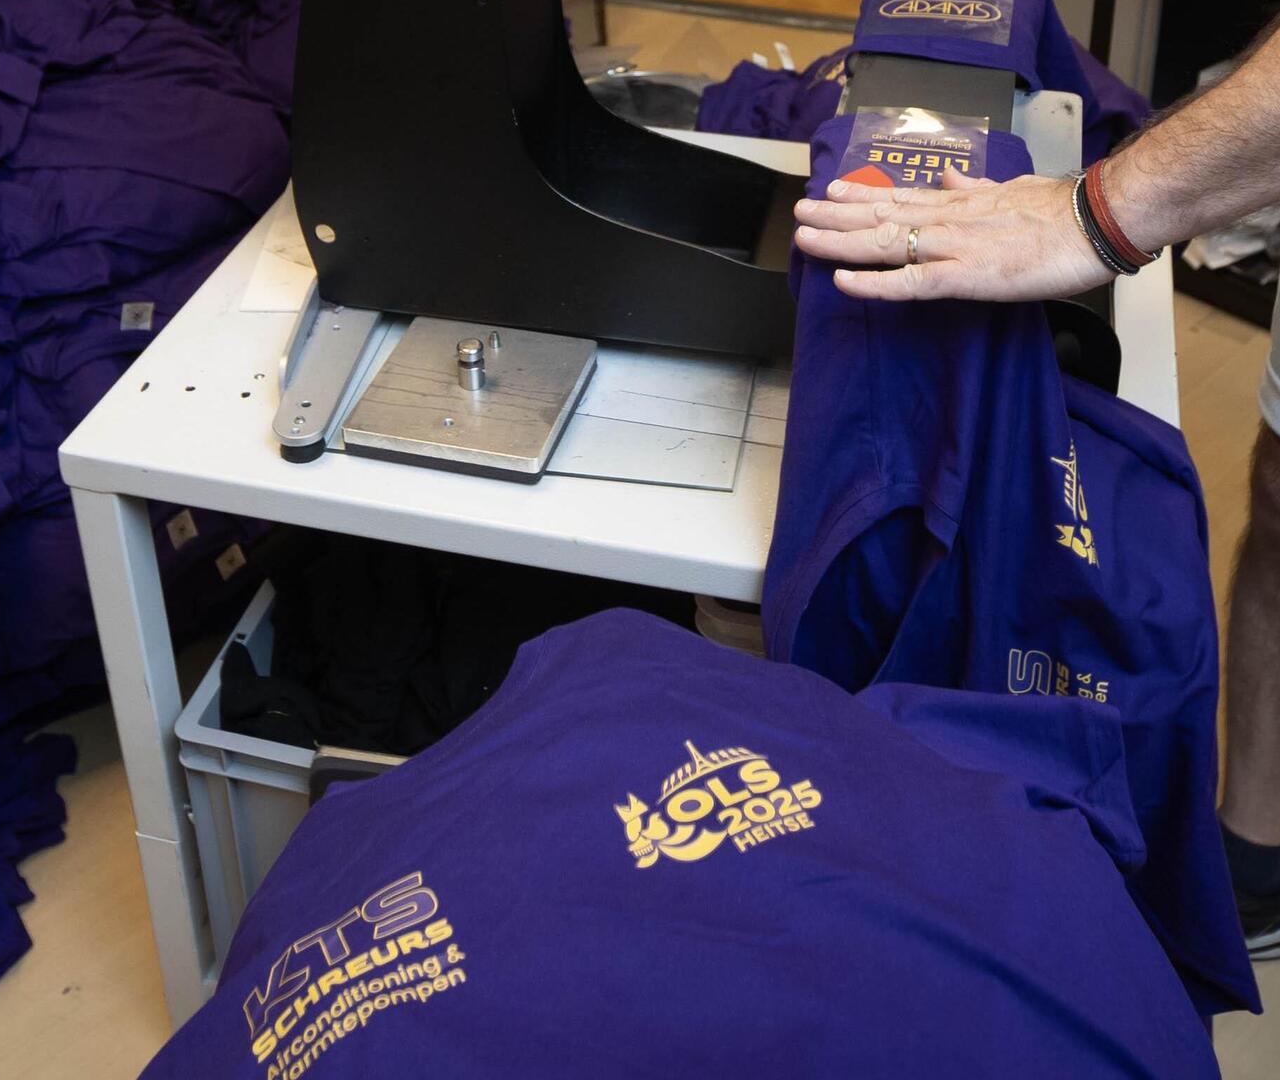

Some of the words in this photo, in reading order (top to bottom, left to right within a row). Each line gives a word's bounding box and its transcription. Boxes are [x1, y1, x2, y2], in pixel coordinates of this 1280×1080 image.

[891, 0, 991, 19] ADAMS
[867, 150, 970, 172] LIEFDE
[901, 169, 943, 183] LE
[667, 760, 780, 823] OLS
[719, 779, 822, 837] 2025
[732, 812, 815, 852] HEITSE
[243, 871, 439, 1040] KTS
[252, 918, 453, 1064] SCHREURS
[267, 955, 441, 1080] Airconditioning
[446, 943, 466, 964] &
[282, 967, 467, 1080] armtepompen
